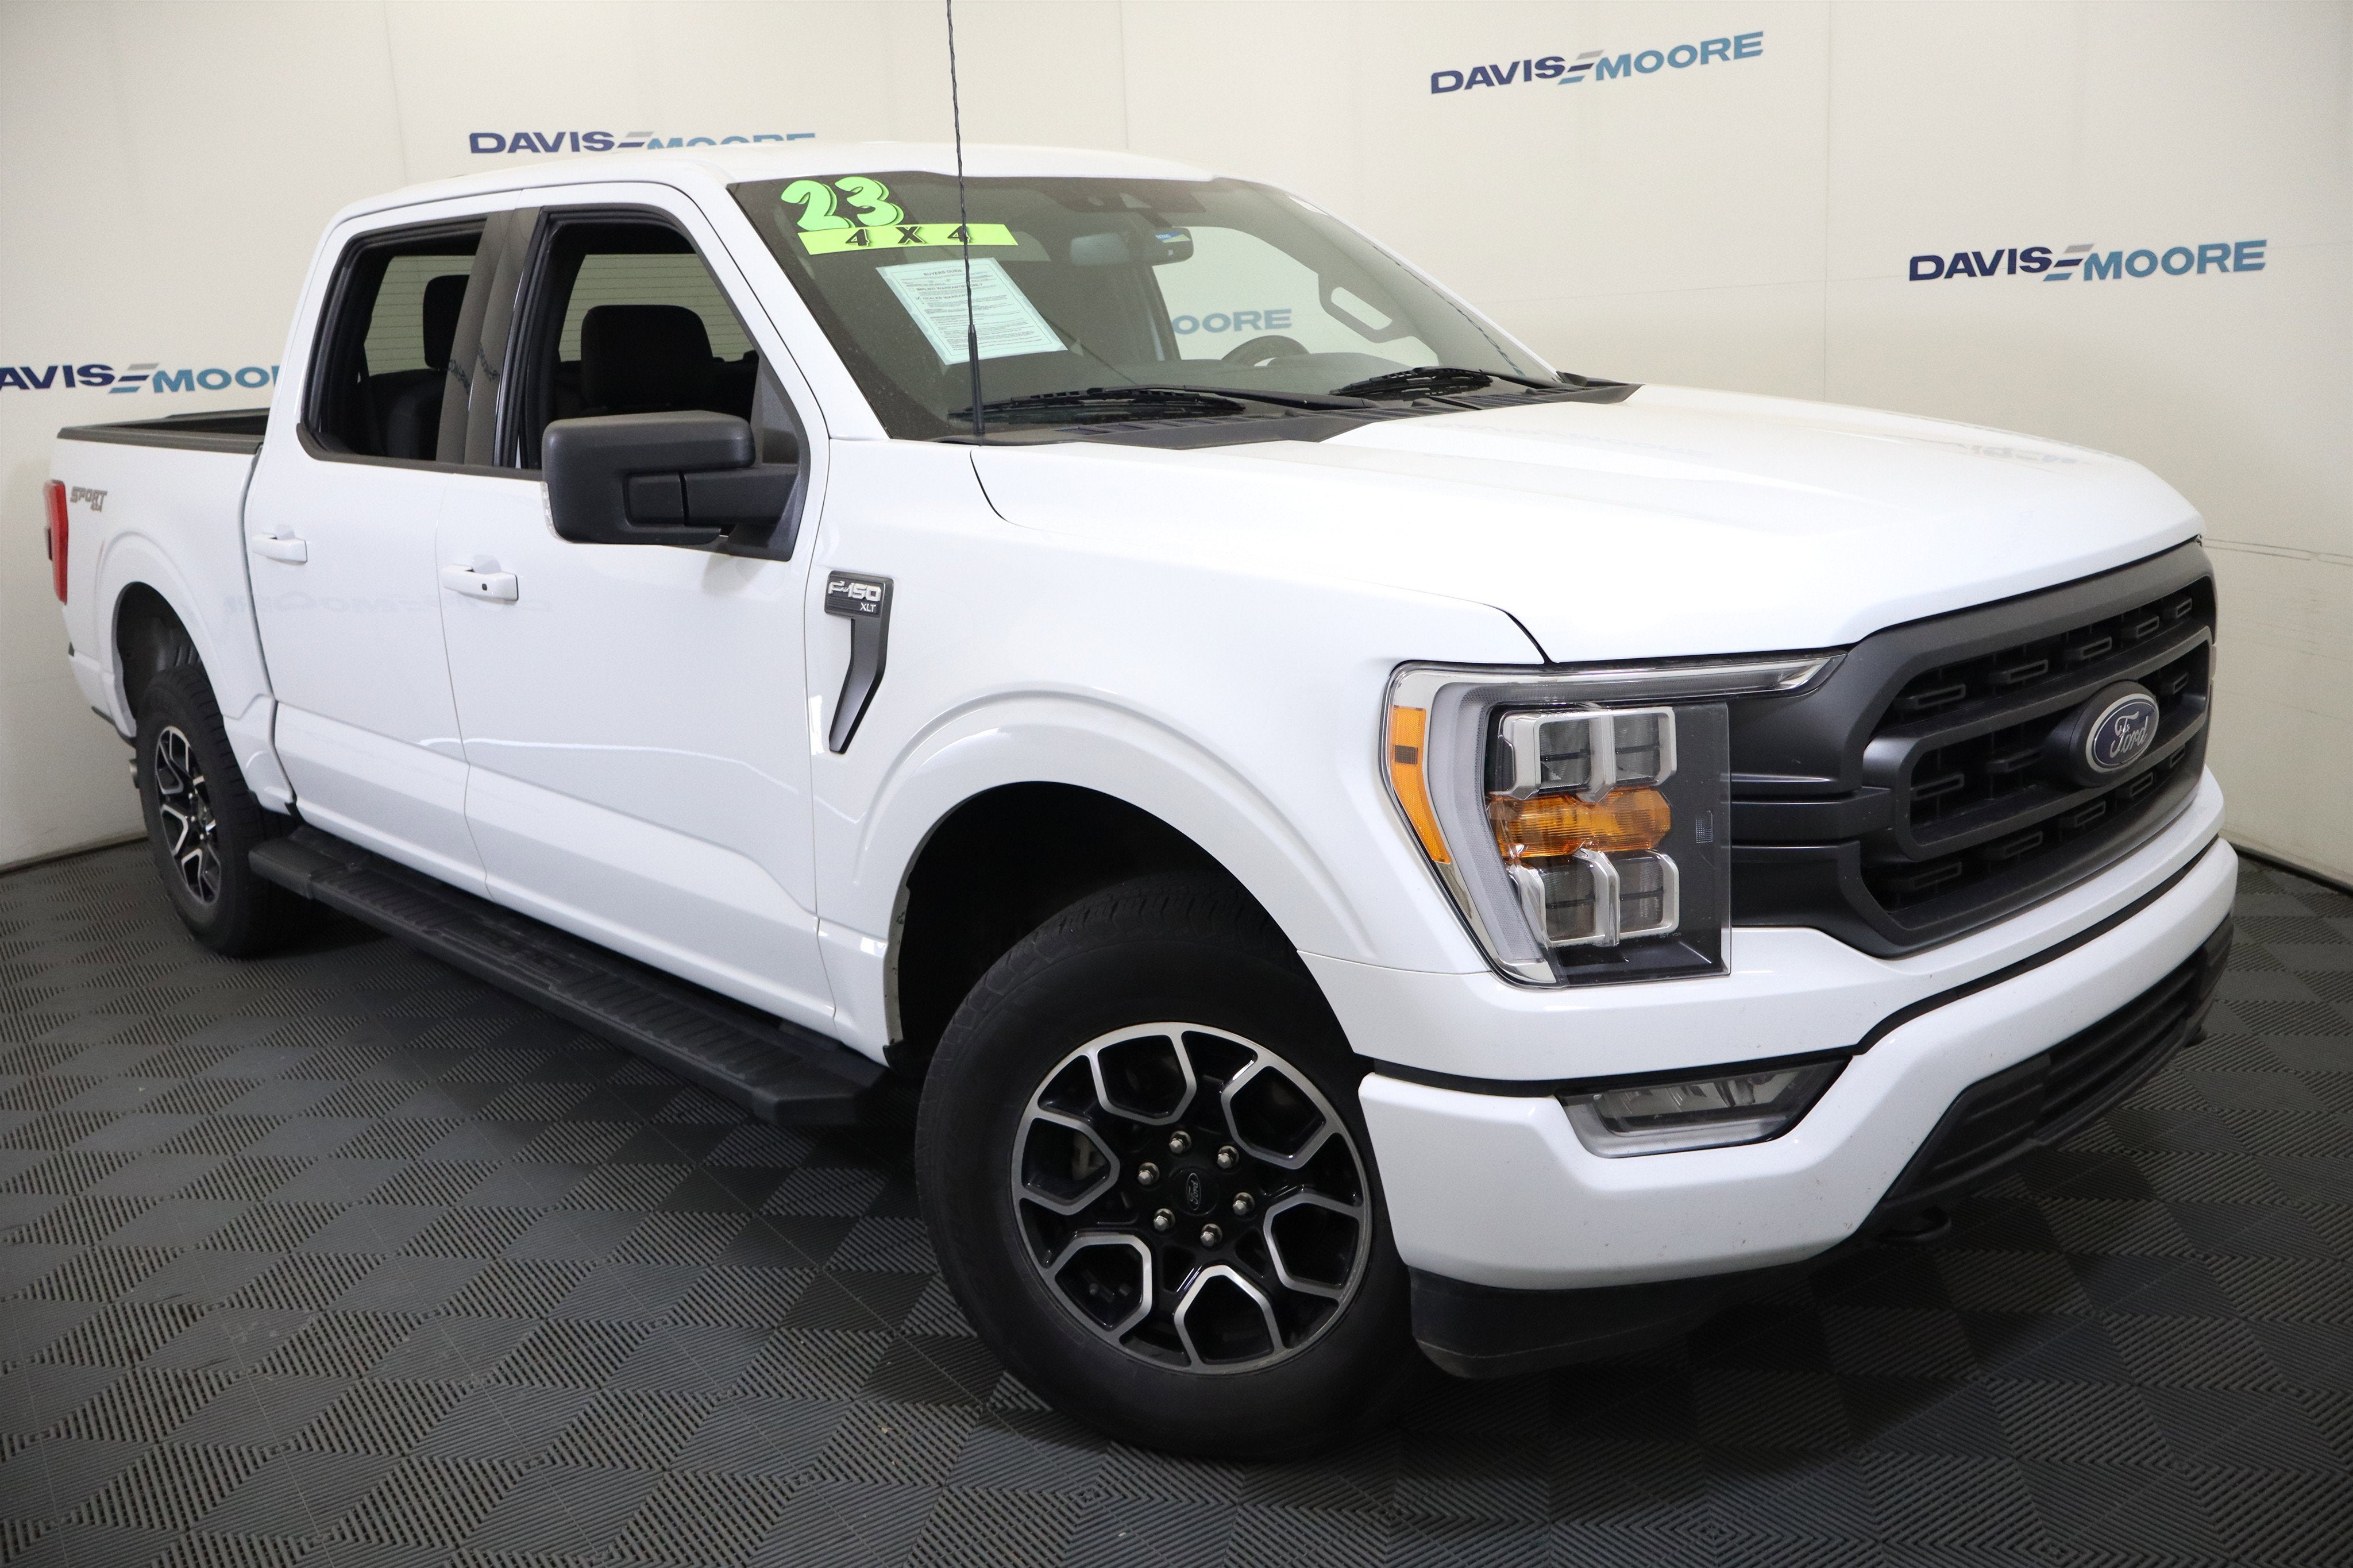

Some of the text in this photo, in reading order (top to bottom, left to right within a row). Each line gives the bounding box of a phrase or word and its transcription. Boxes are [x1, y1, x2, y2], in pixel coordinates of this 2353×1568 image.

[1431, 31, 1764, 94] DAVIS MOORE
[469, 131, 615, 154] DAVIS
[781, 176, 905, 231] 23
[1908, 239, 2267, 281] DAVIS MOORE
[152, 365, 279, 393] MOO
[70, 486, 107, 505] SPORT
[828, 581, 882, 602] F-150
[860, 603, 877, 613] XLT
[2109, 710, 2149, 759] Ford
[1188, 1179, 1199, 1205] Ford
